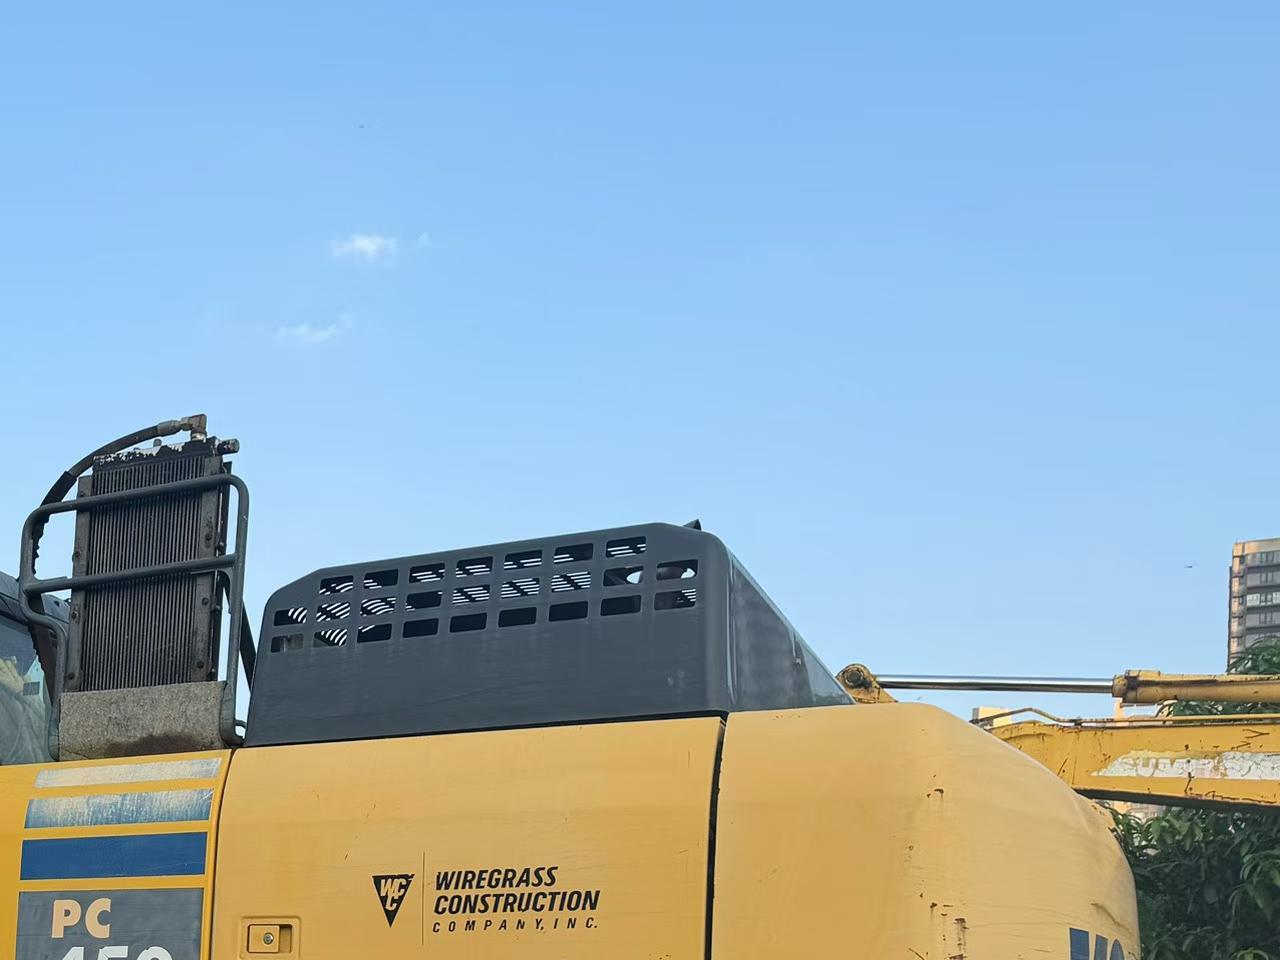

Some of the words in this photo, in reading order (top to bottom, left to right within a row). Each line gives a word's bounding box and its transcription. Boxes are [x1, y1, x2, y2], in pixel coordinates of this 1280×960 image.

[435, 866, 558, 891] WIREGRASS
[433, 890, 600, 915] CONSTRUCTION
[51, 898, 111, 939] PC
